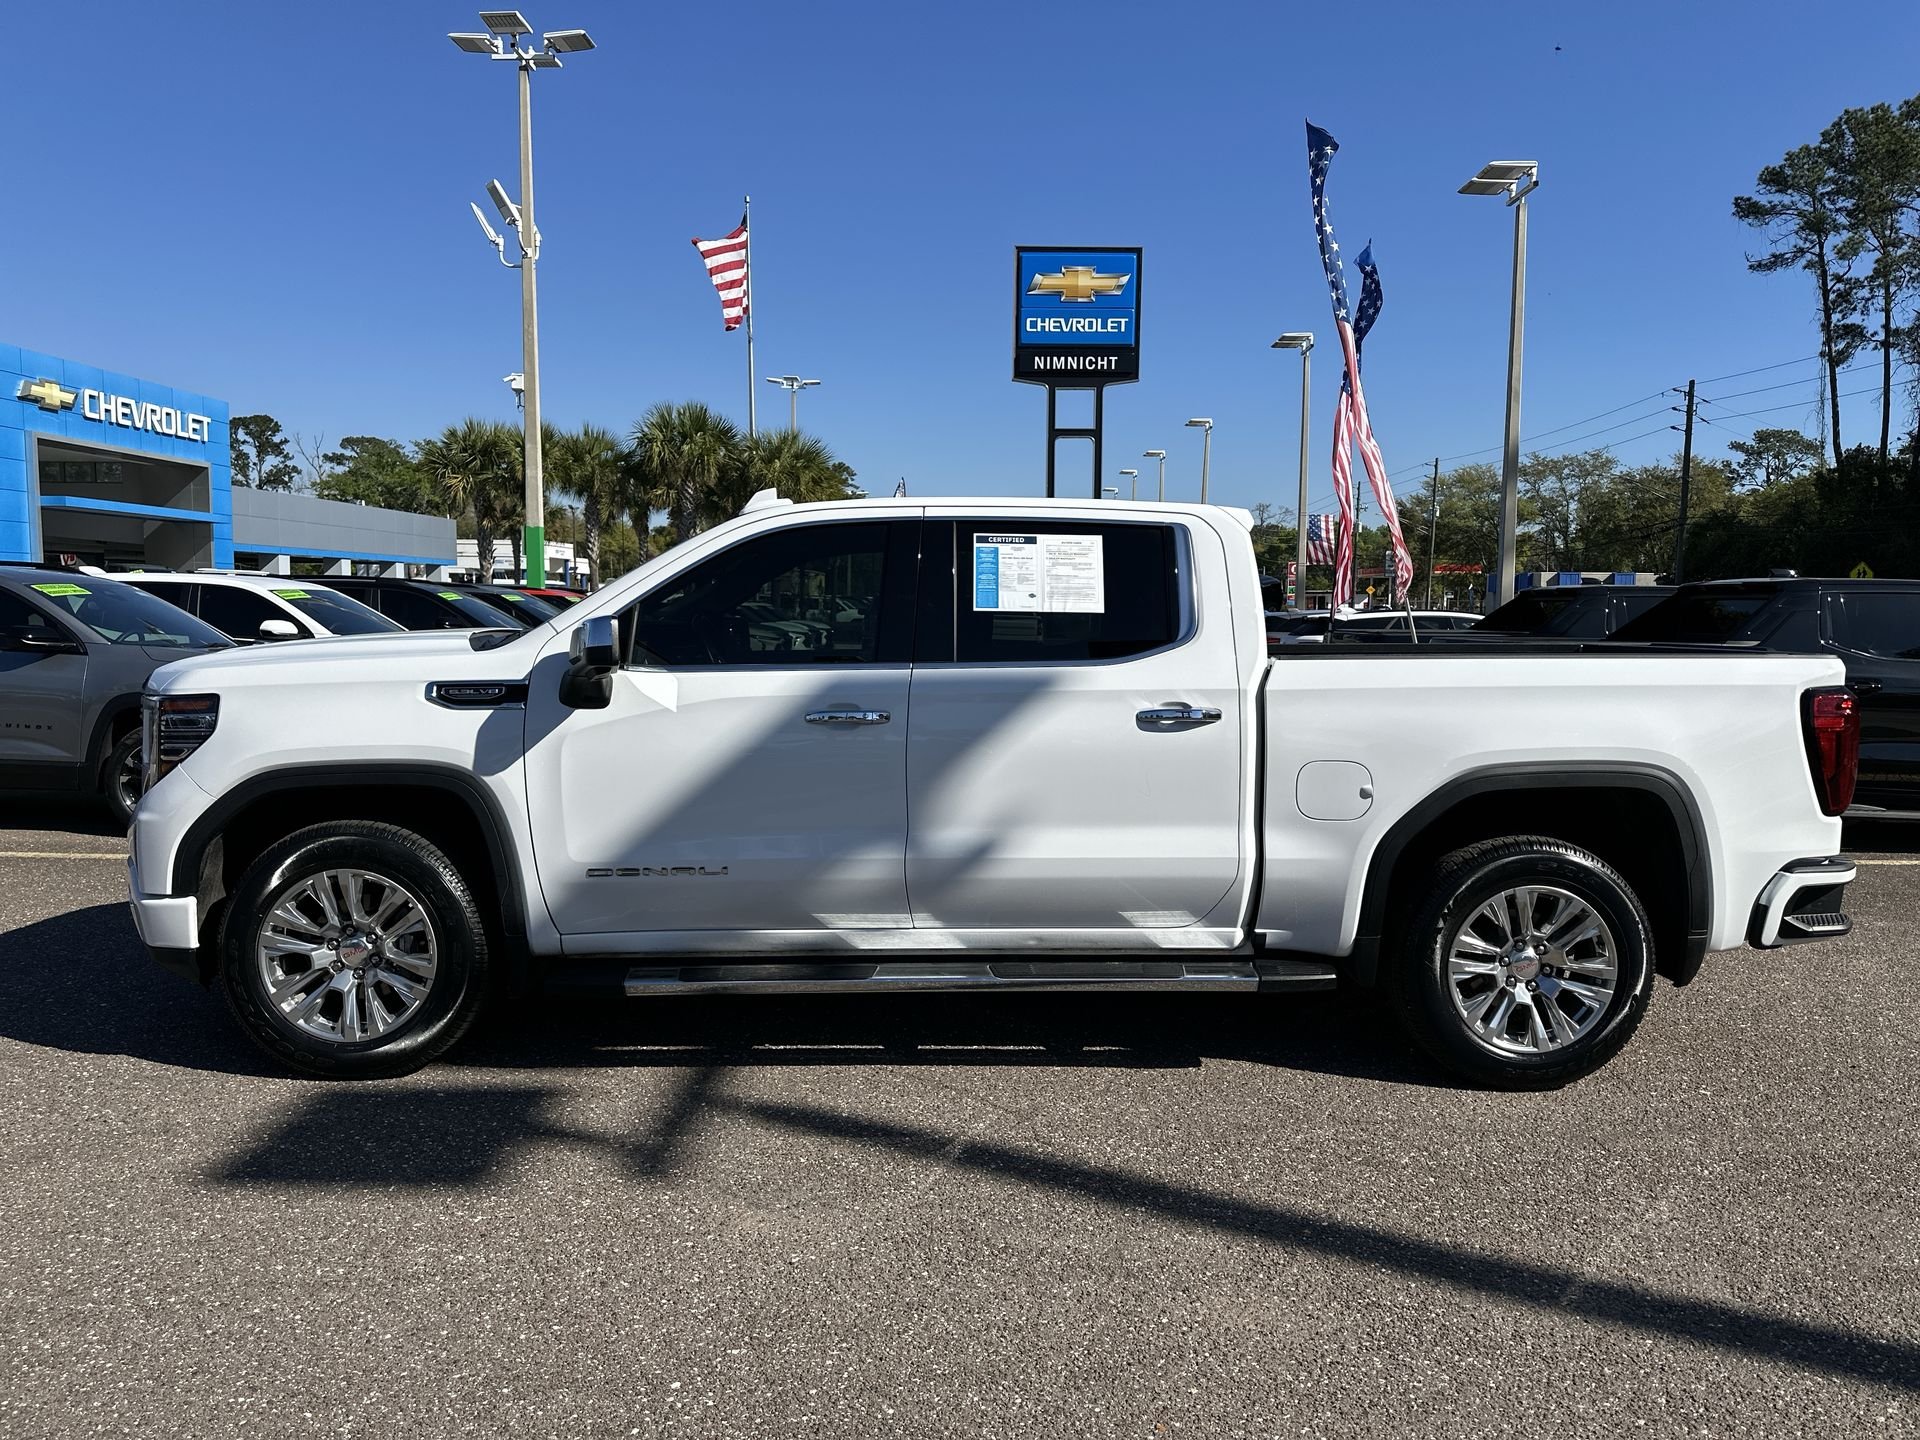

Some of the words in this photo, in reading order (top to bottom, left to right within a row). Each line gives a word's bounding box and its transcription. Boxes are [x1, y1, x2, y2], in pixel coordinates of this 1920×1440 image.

[1026, 318, 1128, 332] CHEVROLET
[1034, 356, 1118, 370] NIMNICHT
[83, 388, 211, 442] CHEVROLET
[586, 866, 728, 878] DENALI
[343, 946, 367, 959] GMC
